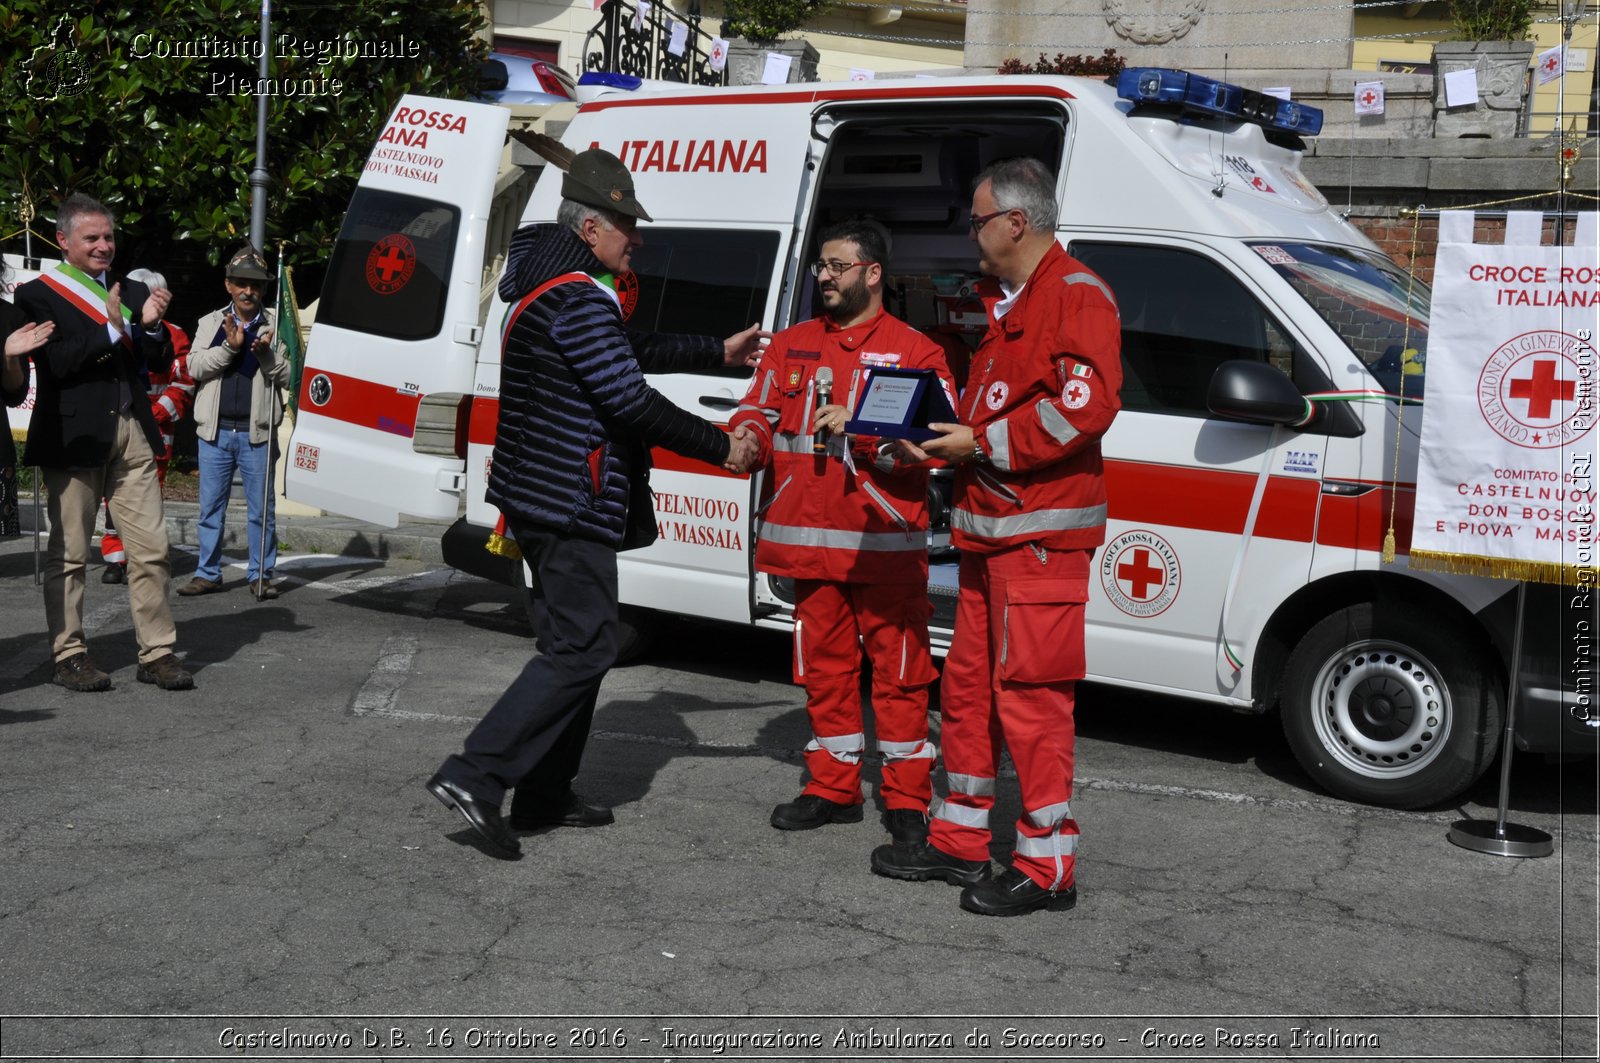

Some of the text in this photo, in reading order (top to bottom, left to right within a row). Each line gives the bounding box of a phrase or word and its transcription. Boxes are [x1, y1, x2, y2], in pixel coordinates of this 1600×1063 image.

[394, 107, 467, 134] ROSSA
[620, 140, 767, 173] ITALIANA
[393, 165, 438, 184] MASSAIA
[1469, 264, 1547, 284] CROCE
[1497, 288, 1600, 308] ITALIANA
[1502, 343, 1520, 361] DI
[404, 381, 420, 391] TDI
[476, 383, 496, 393] Dono
[295, 456, 318, 471] 12-25
[1494, 468, 1558, 482] COMITATO
[1468, 504, 1596, 525] DON BOSCO
[1436, 520, 1446, 532] E
[673, 522, 743, 551] MASSAIA
[1104, 533, 1178, 586] CROCE ROSSA ITALIANA
